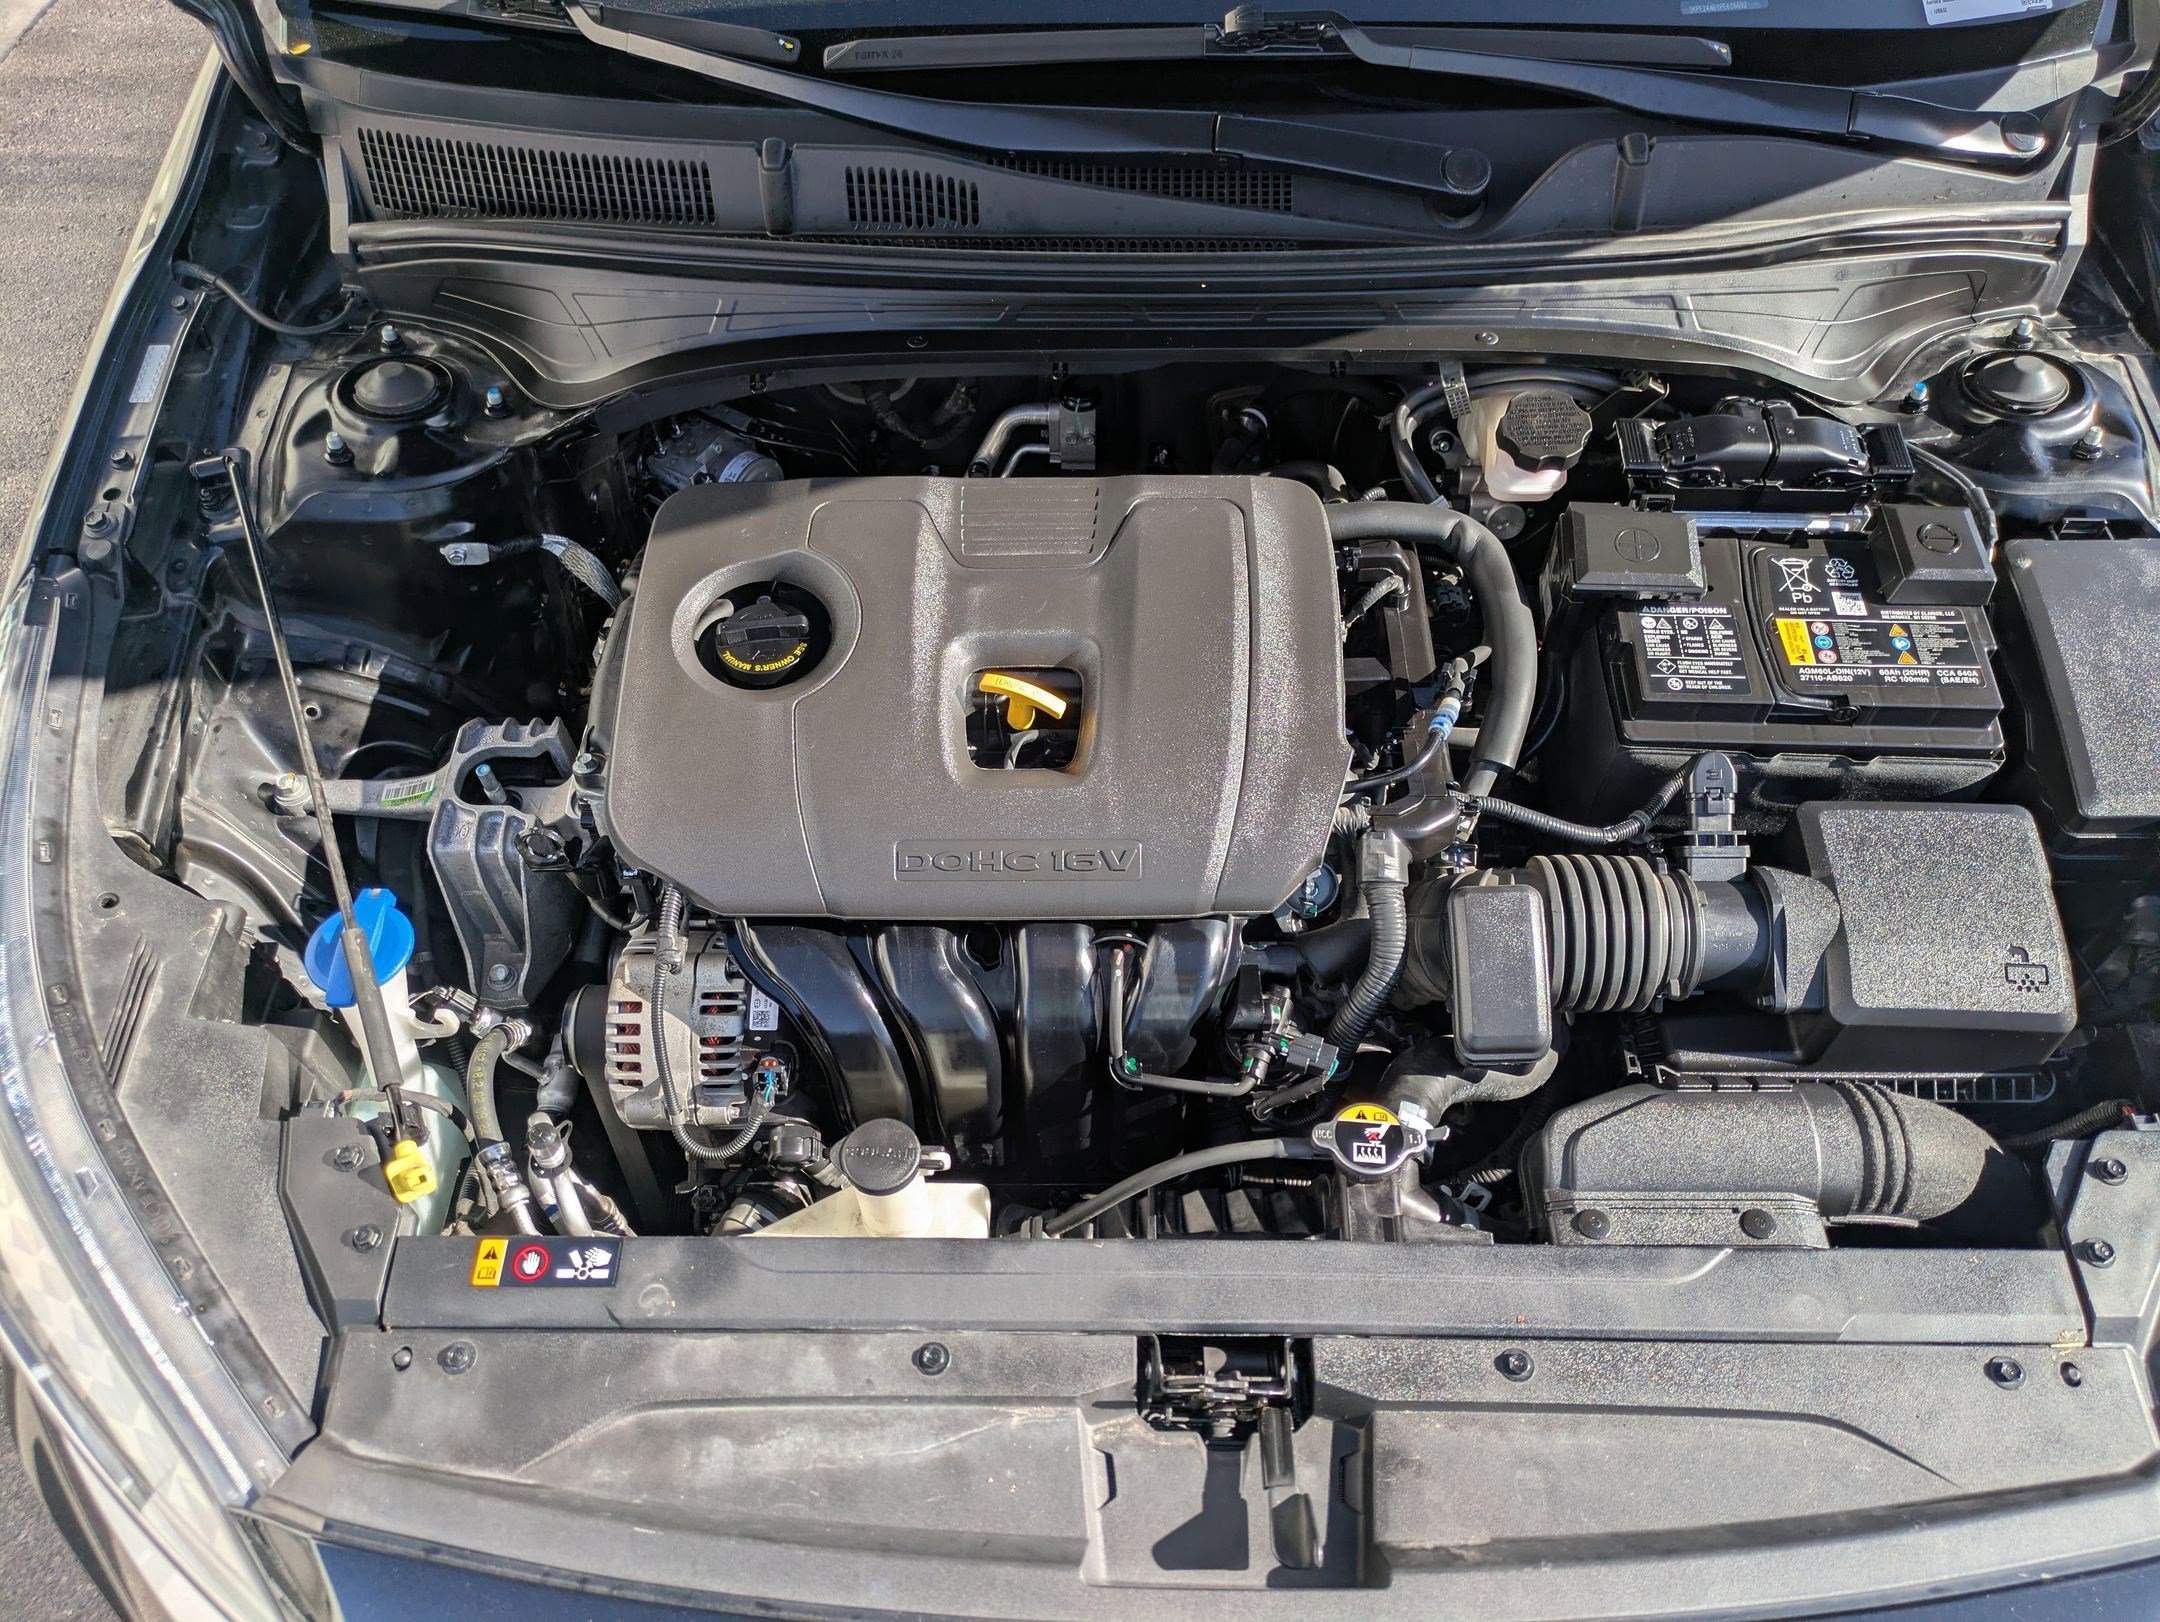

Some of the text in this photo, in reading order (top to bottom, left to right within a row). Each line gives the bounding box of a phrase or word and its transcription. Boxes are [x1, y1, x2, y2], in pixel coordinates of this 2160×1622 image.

[1791, 592, 1813, 603] Pb
[1650, 606, 1728, 615] DANGER/POISON
[724, 642, 808, 672] SEE OWNER'S MANUAL
[1798, 667, 1871, 677] AGM60L-DIN(12V)
[1902, 669, 1931, 677] (20HR)
[1800, 674, 1854, 682] 37110-AB620
[1940, 676, 1980, 685] (SAE/EN)
[895, 849, 1139, 873] DOHC 16V
[1314, 1129, 1333, 1140] HCC
[1408, 1133, 1422, 1145] 1.1
